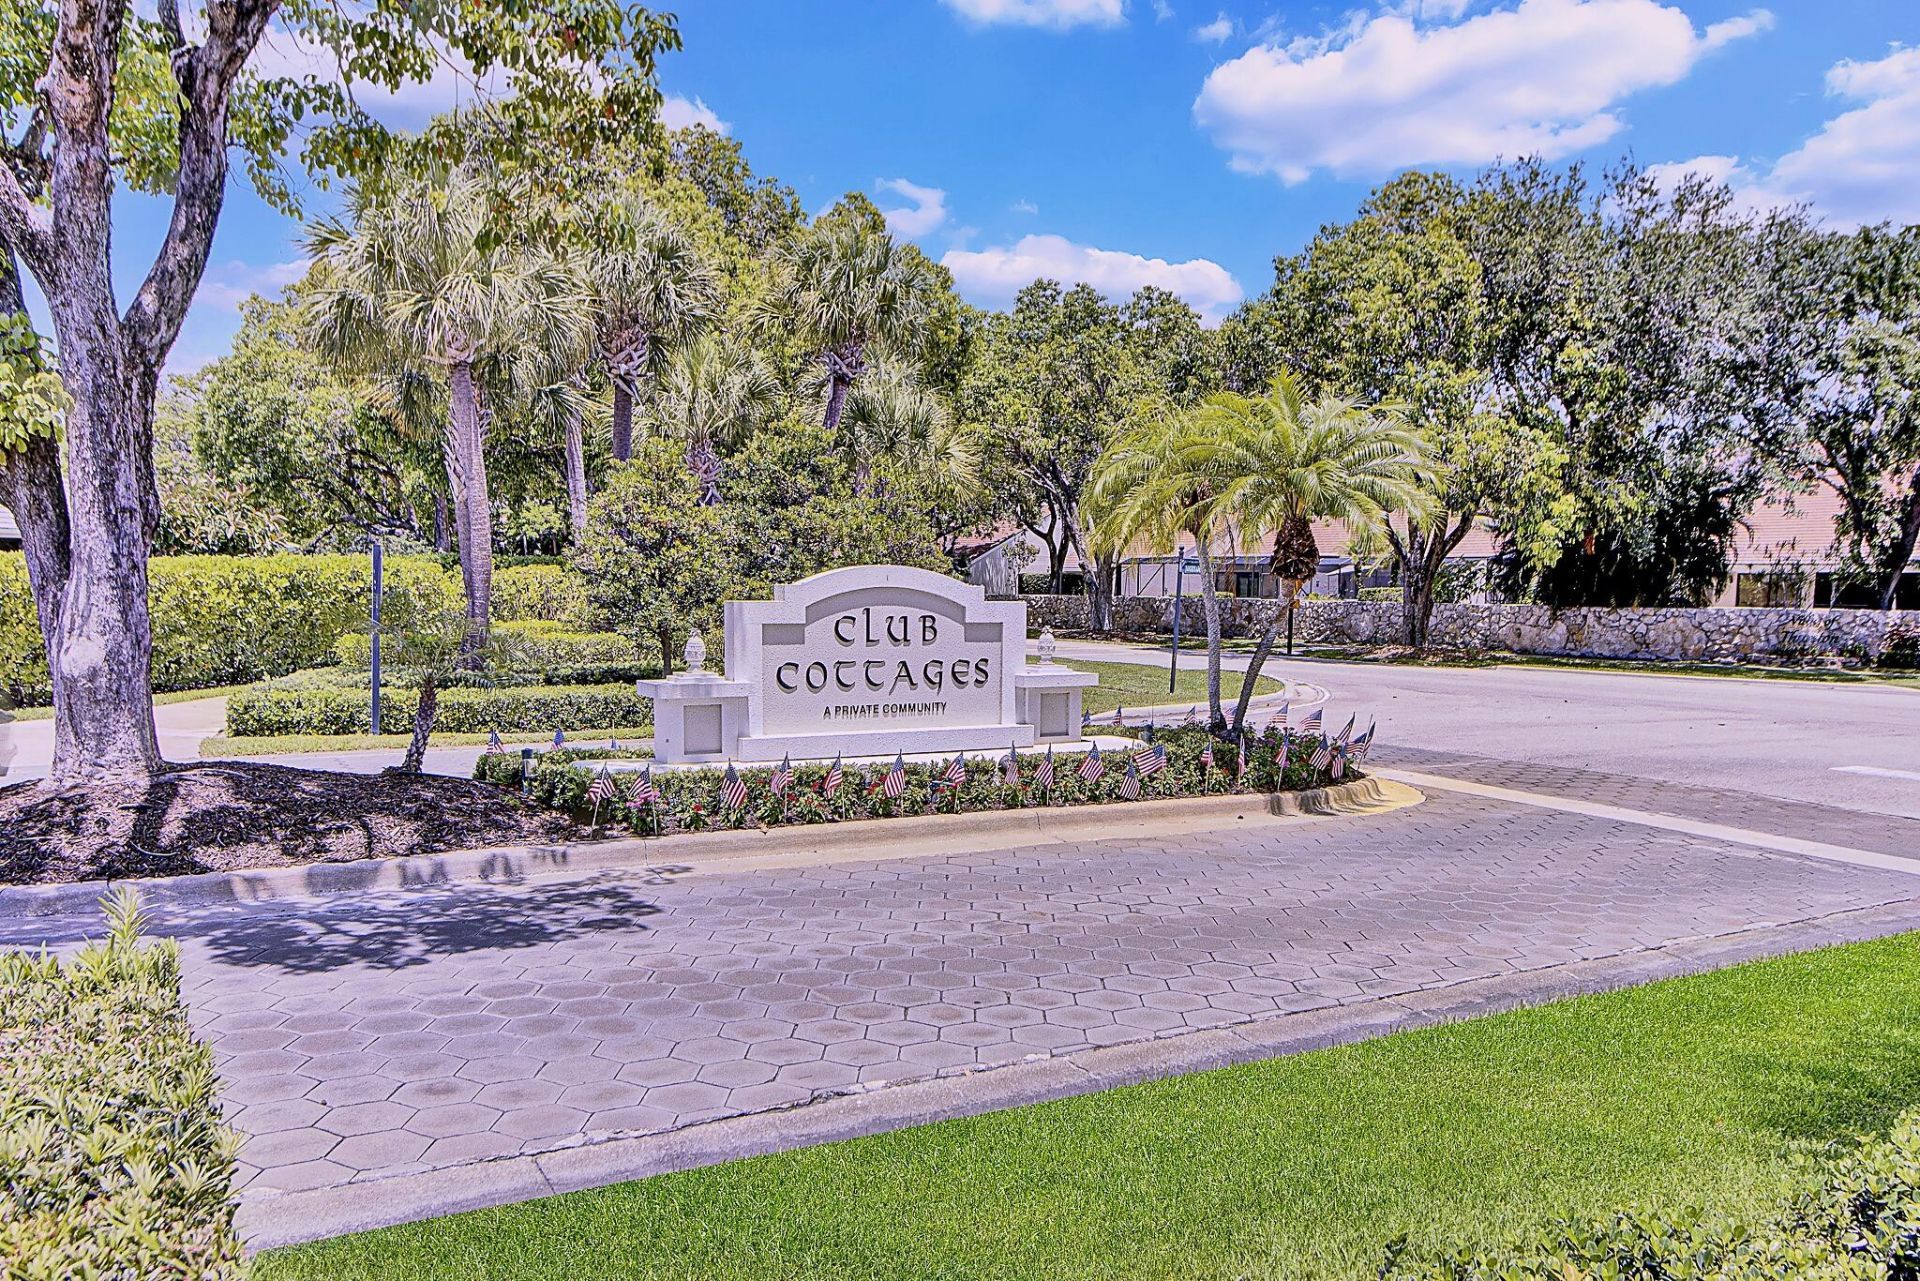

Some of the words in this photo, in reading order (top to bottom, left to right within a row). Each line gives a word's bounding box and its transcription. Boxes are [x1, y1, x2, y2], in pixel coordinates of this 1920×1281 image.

[1823, 615, 1841, 631] of
[823, 706, 832, 717] A
[834, 703, 880, 717] PRIVATE
[882, 701, 947, 715] COMMUNITY
